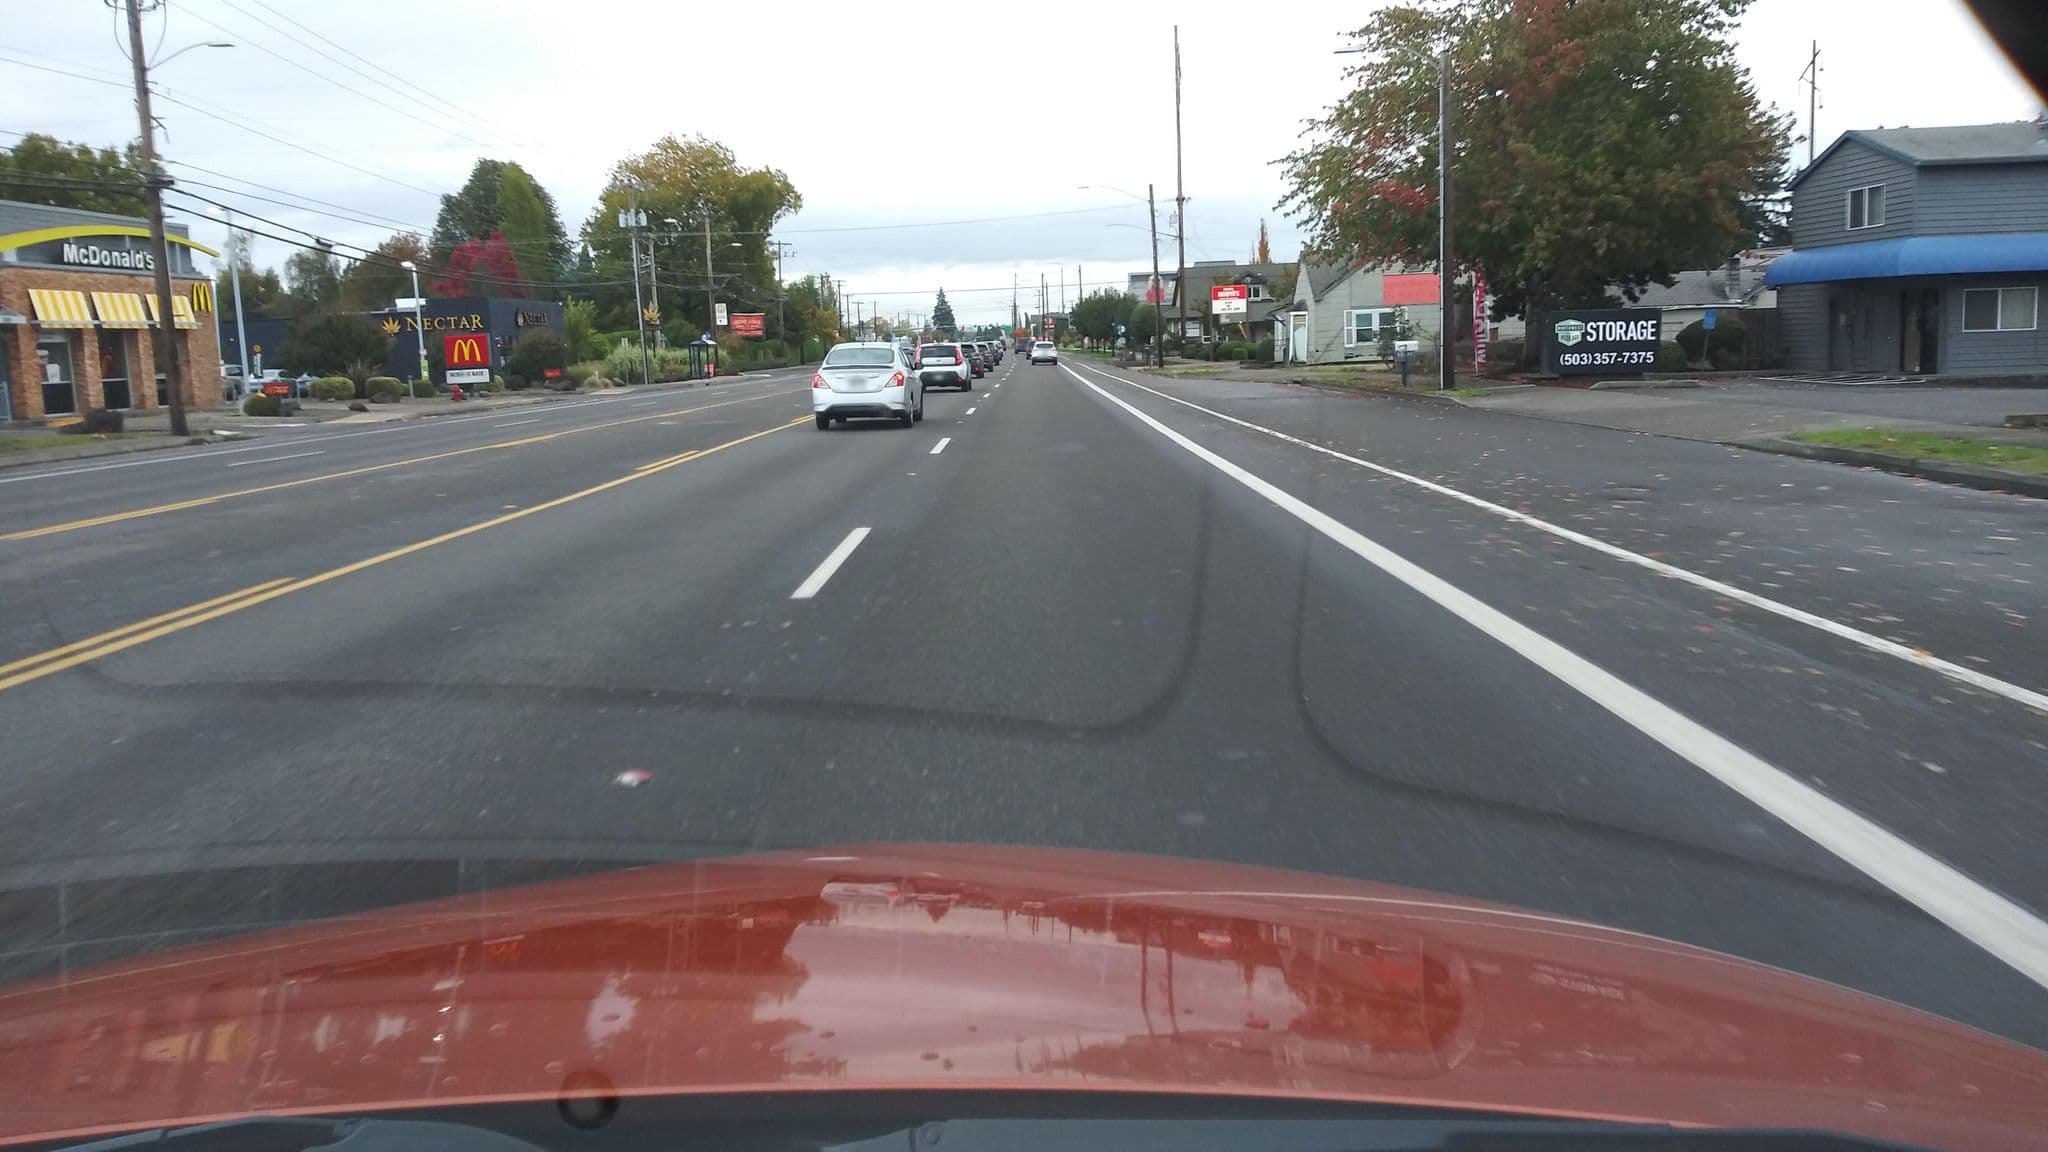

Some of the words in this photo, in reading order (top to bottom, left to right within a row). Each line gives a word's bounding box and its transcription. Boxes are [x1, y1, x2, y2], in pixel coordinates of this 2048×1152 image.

[63, 243, 155, 269] McDonald's
[405, 314, 484, 332] NECTAR
[1586, 320, 1657, 342] STORAGE
